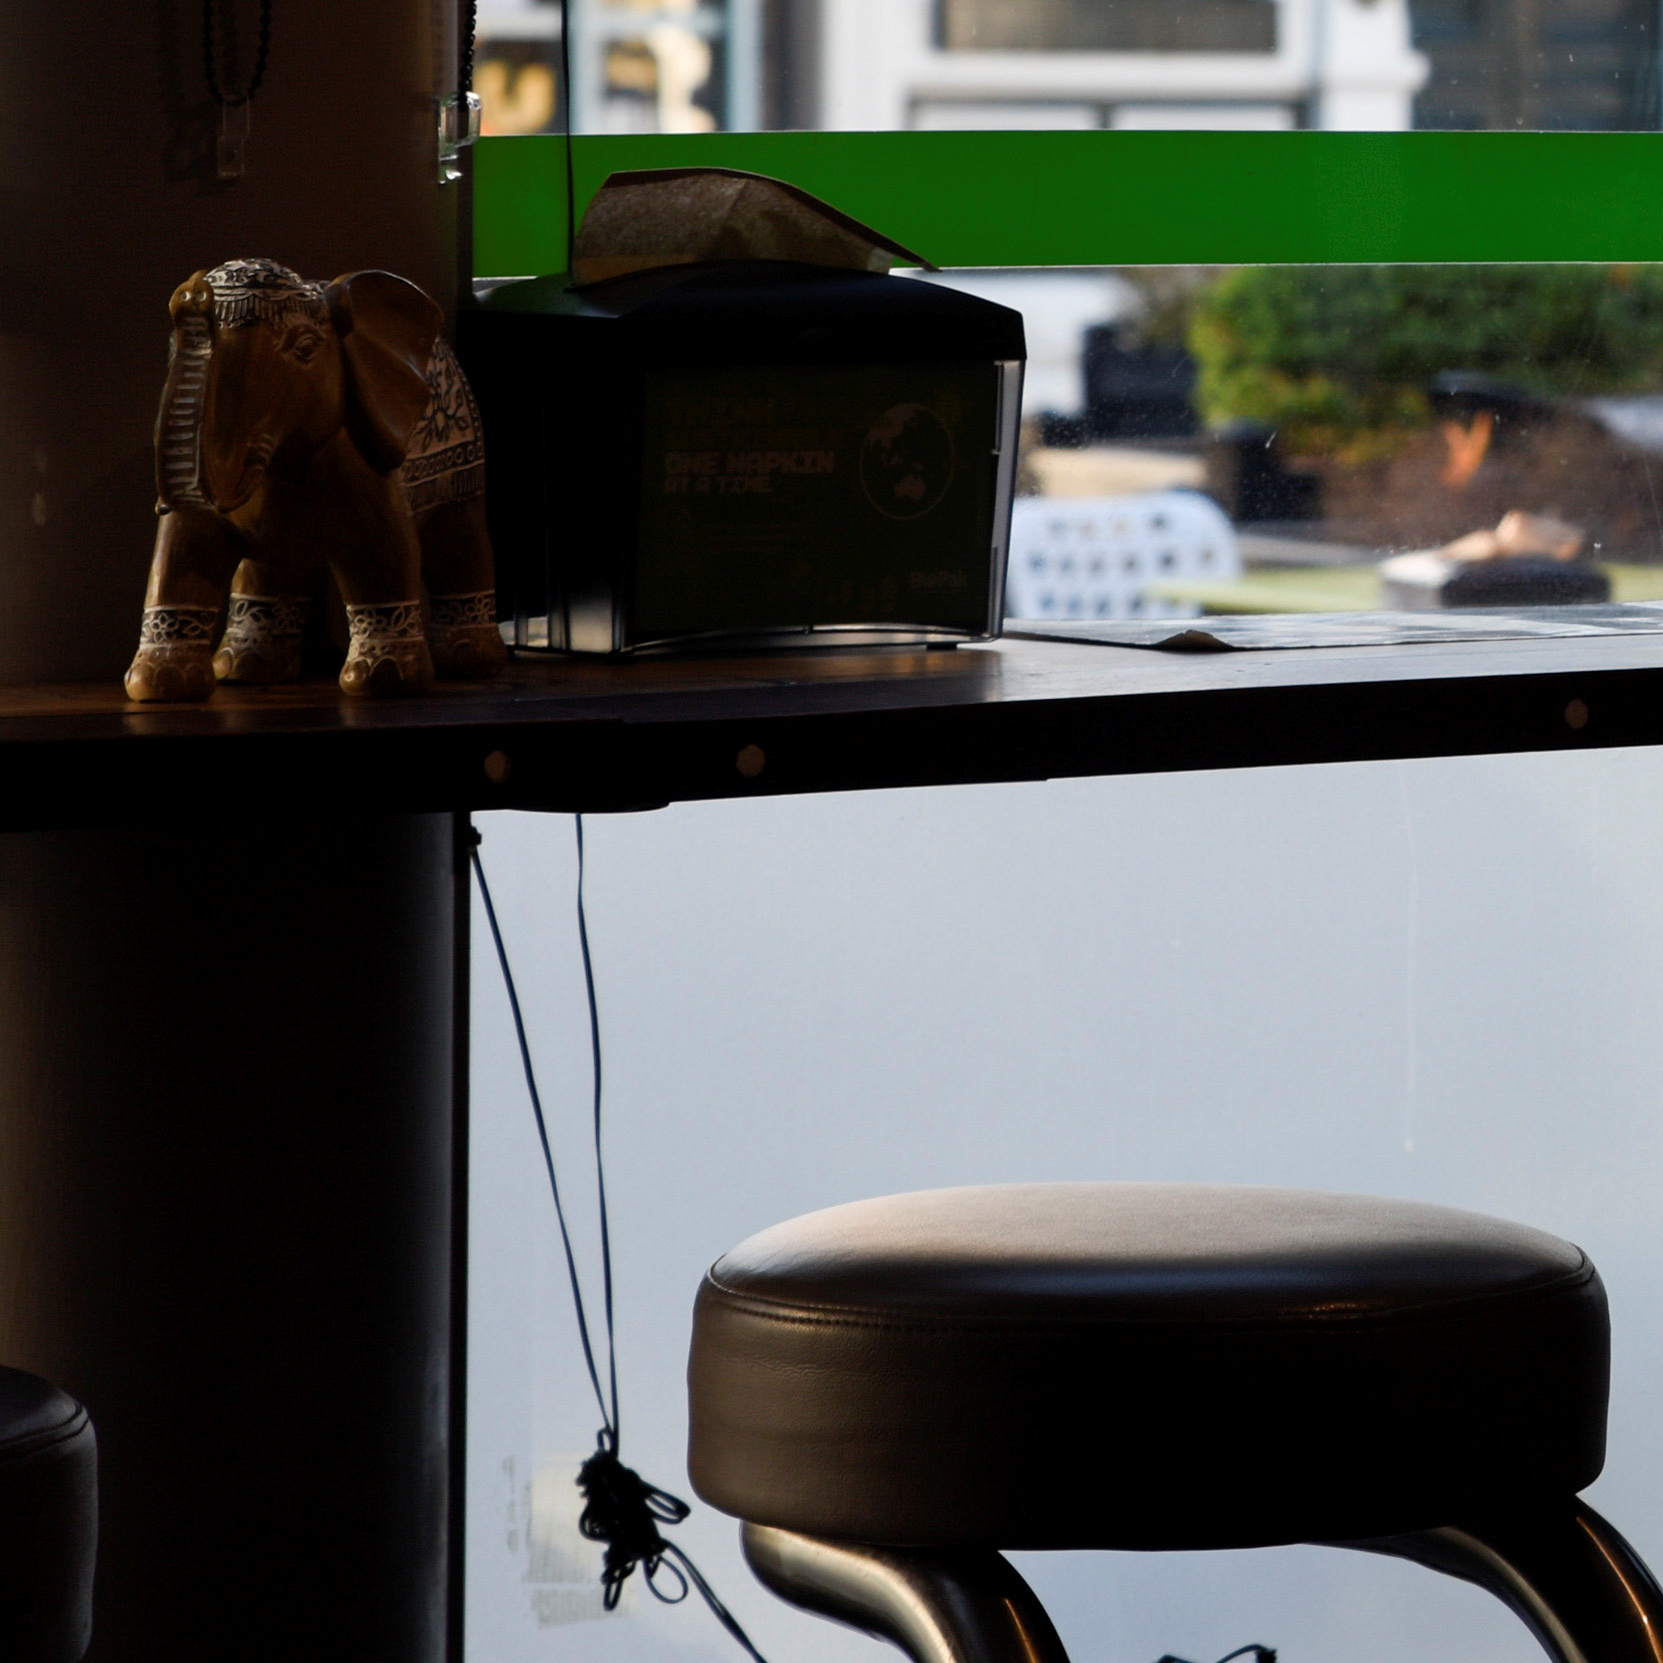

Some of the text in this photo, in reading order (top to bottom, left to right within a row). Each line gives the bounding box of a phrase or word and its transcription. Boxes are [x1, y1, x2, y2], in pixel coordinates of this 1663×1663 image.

[664, 449, 835, 475] ONE NAPKIN
[718, 475, 773, 494] TIME
